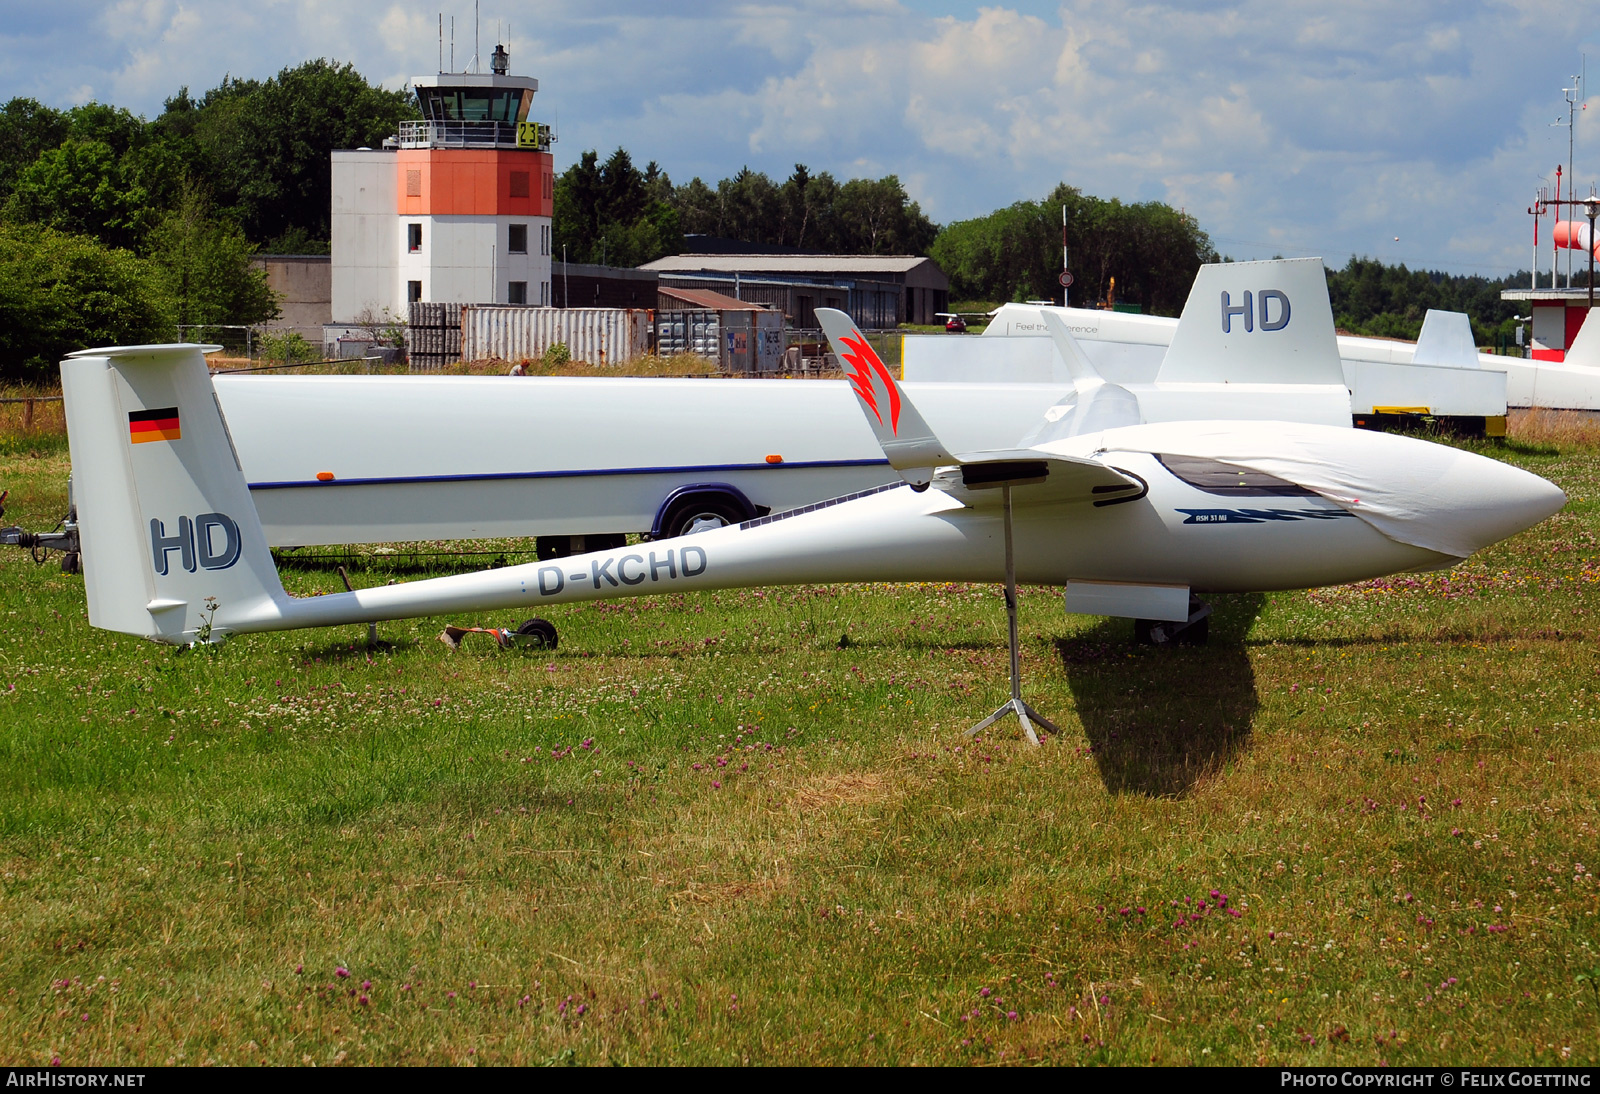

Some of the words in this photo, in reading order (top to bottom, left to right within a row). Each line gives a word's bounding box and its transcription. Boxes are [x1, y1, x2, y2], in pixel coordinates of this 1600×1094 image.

[520, 123, 536, 143] 23
[1015, 322, 1035, 331] Feel
[1221, 289, 1291, 333] HD
[150, 512, 242, 576] HD
[537, 546, 707, 597] D-KCHD
